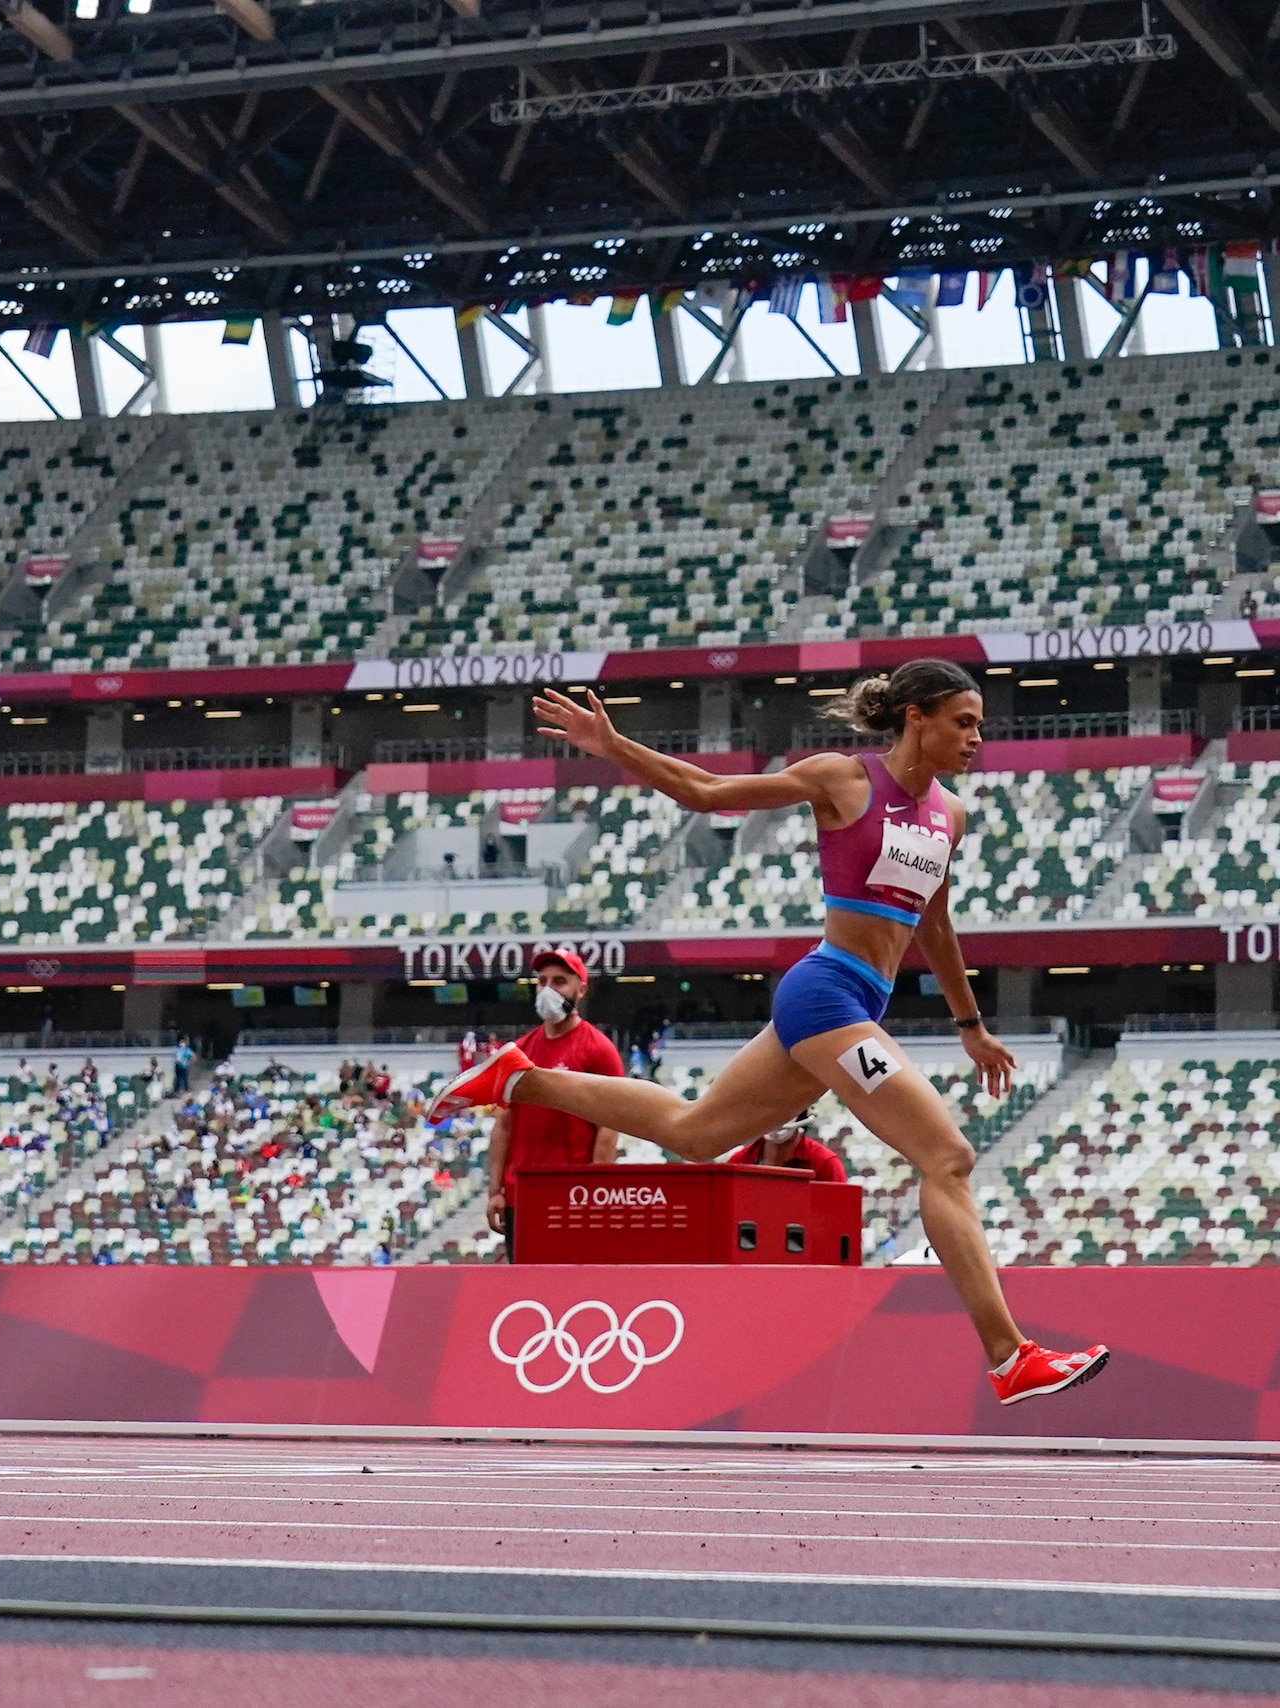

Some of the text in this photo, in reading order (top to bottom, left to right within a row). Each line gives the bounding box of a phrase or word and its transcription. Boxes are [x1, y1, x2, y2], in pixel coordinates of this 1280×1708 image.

[1026, 622, 1213, 661] TOKYO 2020
[392, 653, 564, 689] TOKYO 2020
[398, 939, 626, 980] TOKYO 20
[1219, 923, 1280, 963] TO
[857, 1046, 888, 1080] 4
[592, 1187, 668, 1205] OMEGA
